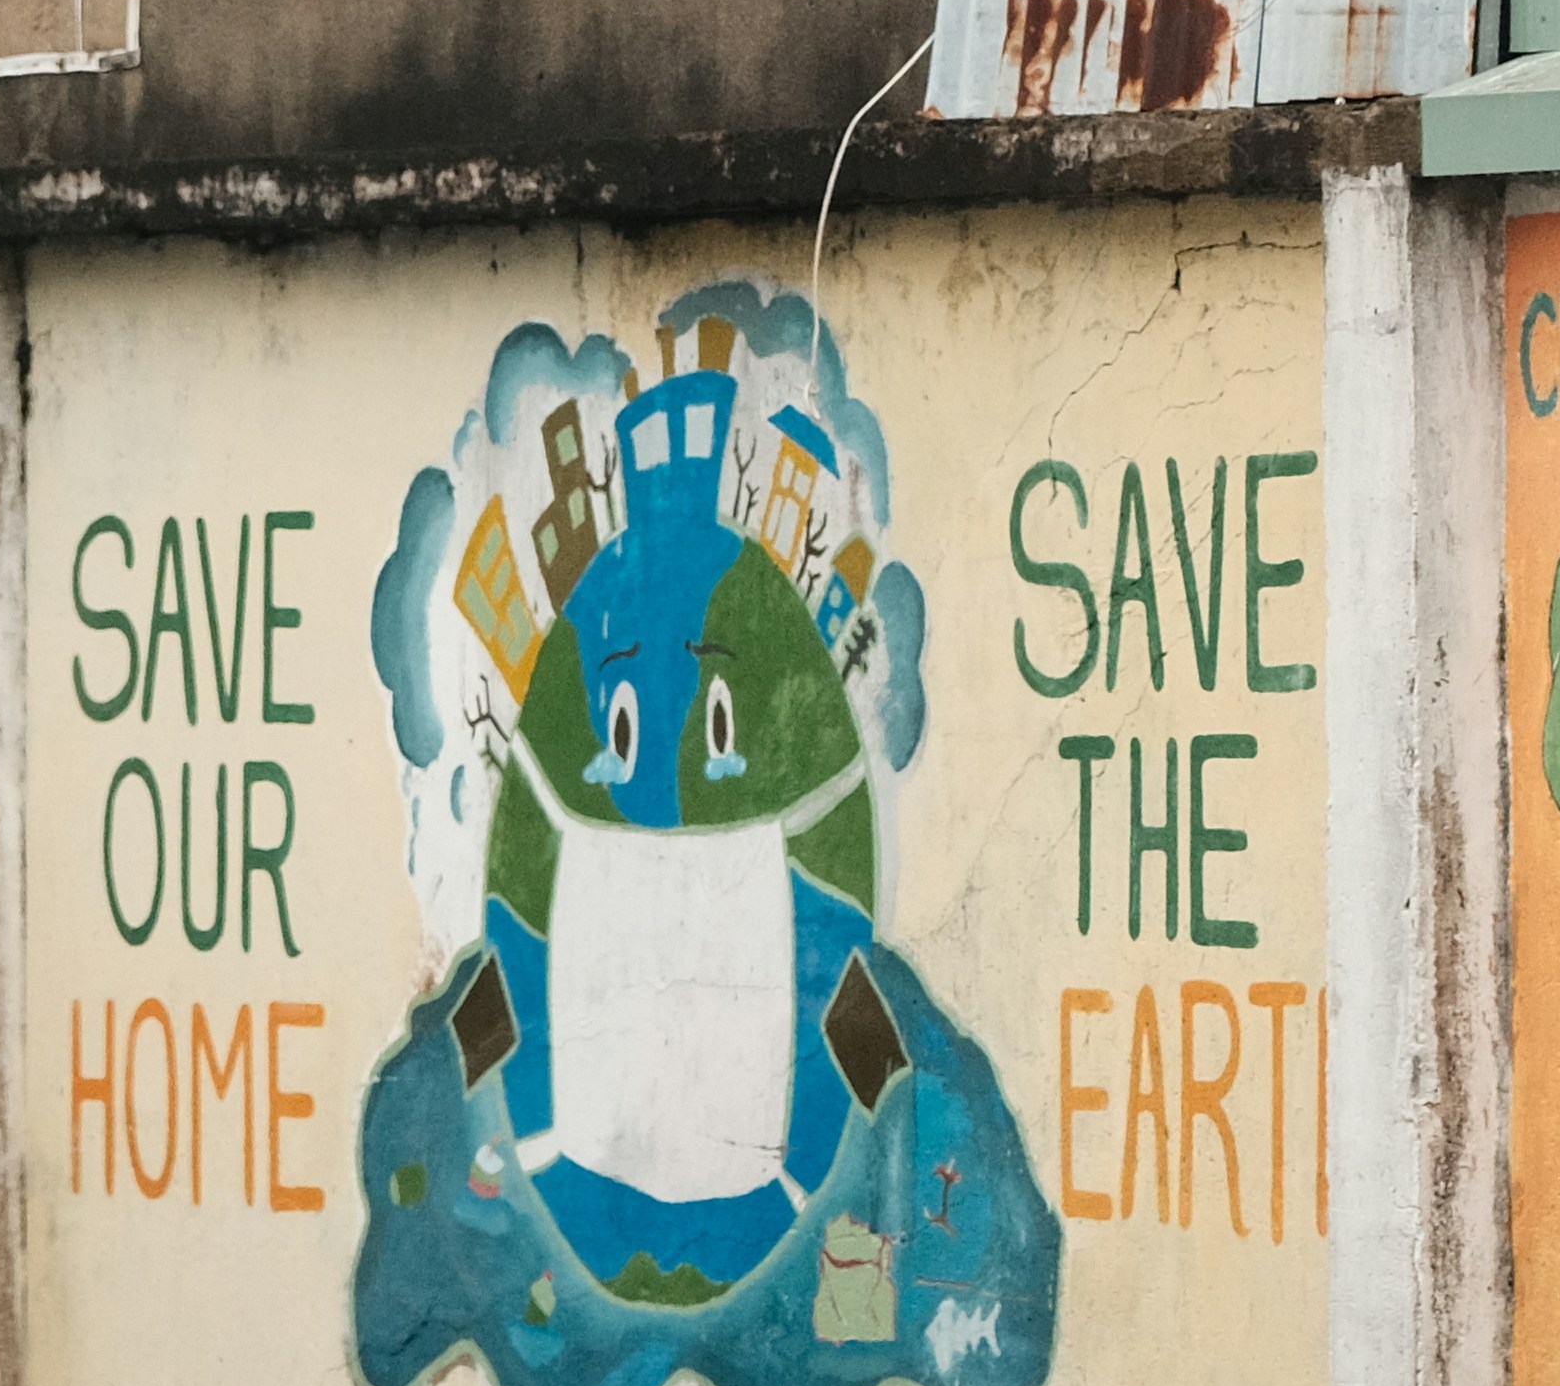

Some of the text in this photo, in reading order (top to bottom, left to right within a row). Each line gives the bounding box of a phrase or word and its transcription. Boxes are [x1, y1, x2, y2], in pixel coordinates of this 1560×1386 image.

[72, 510, 316, 725] SAVE
[1009, 450, 1319, 699] SAVE
[103, 756, 302, 958] OUR
[1058, 734, 1260, 950] THE
[71, 997, 326, 1212] HOME
